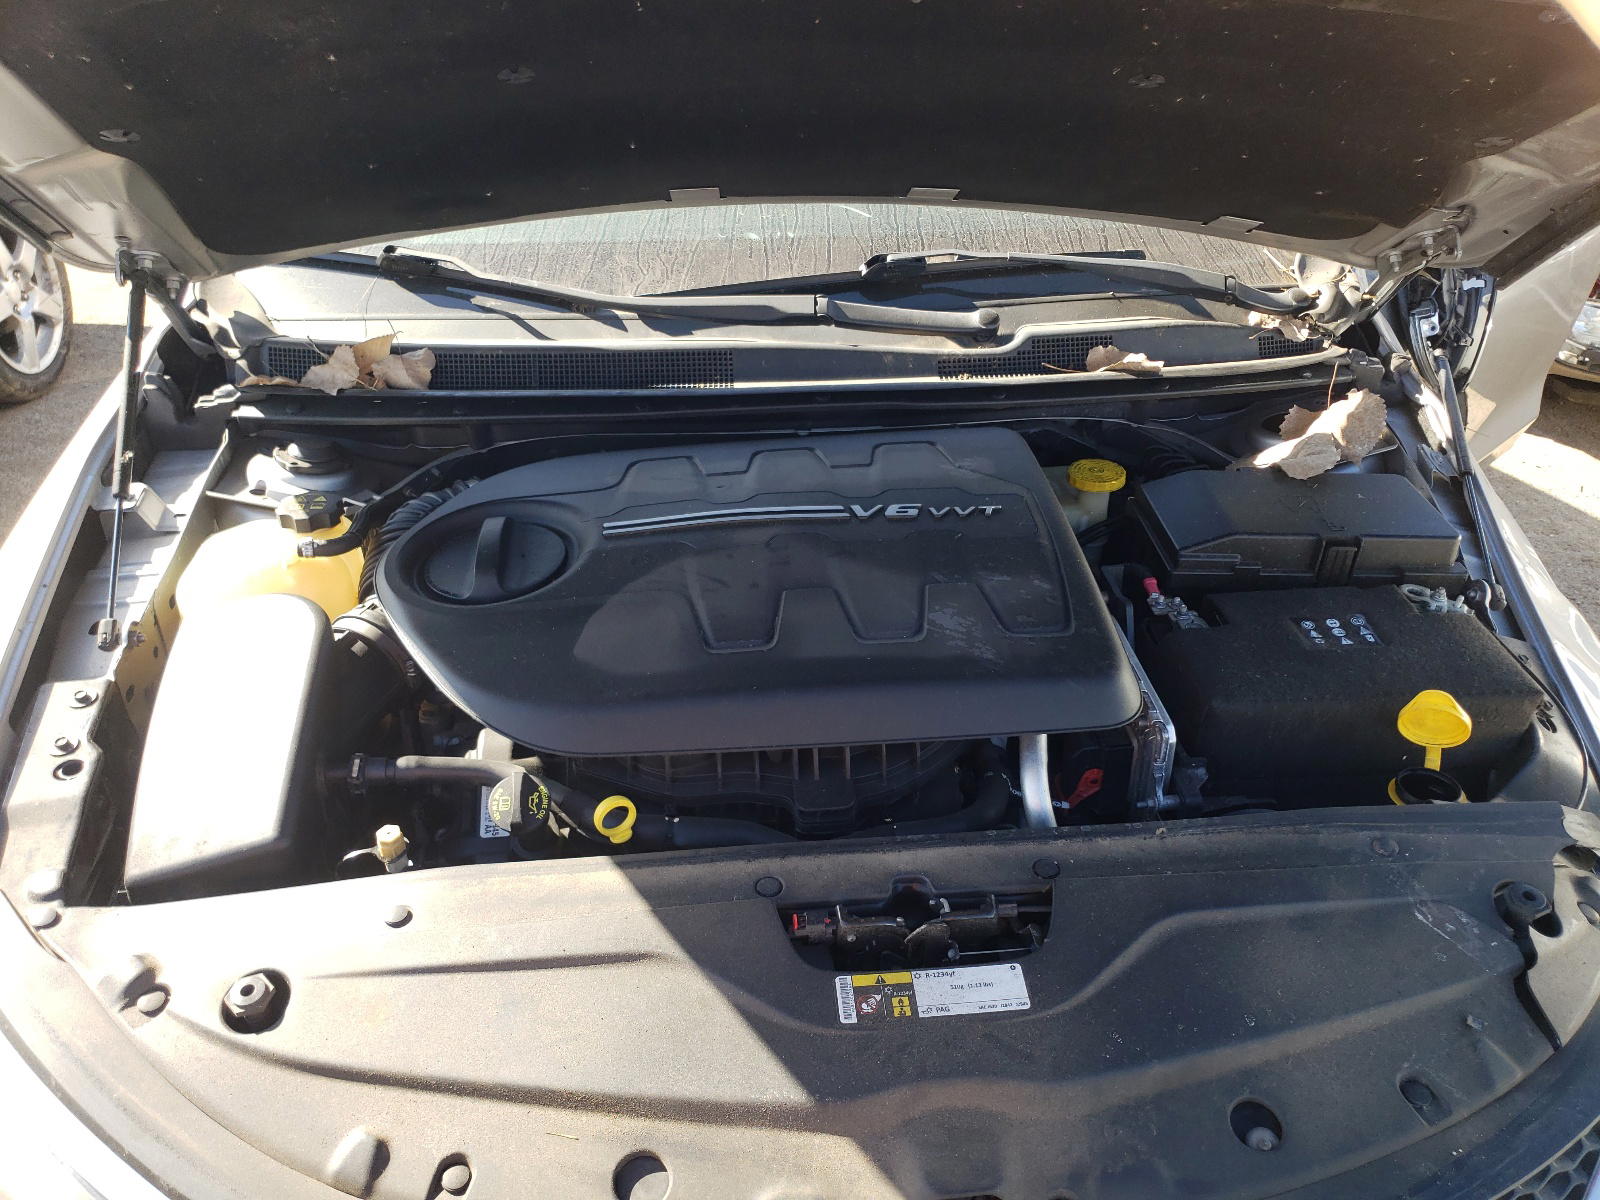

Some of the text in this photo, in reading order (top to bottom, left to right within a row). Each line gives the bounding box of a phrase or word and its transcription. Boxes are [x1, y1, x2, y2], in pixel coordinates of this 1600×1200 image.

[850, 503, 1002, 518] V6 VVT
[536, 786, 548, 819] ENGINE OIL
